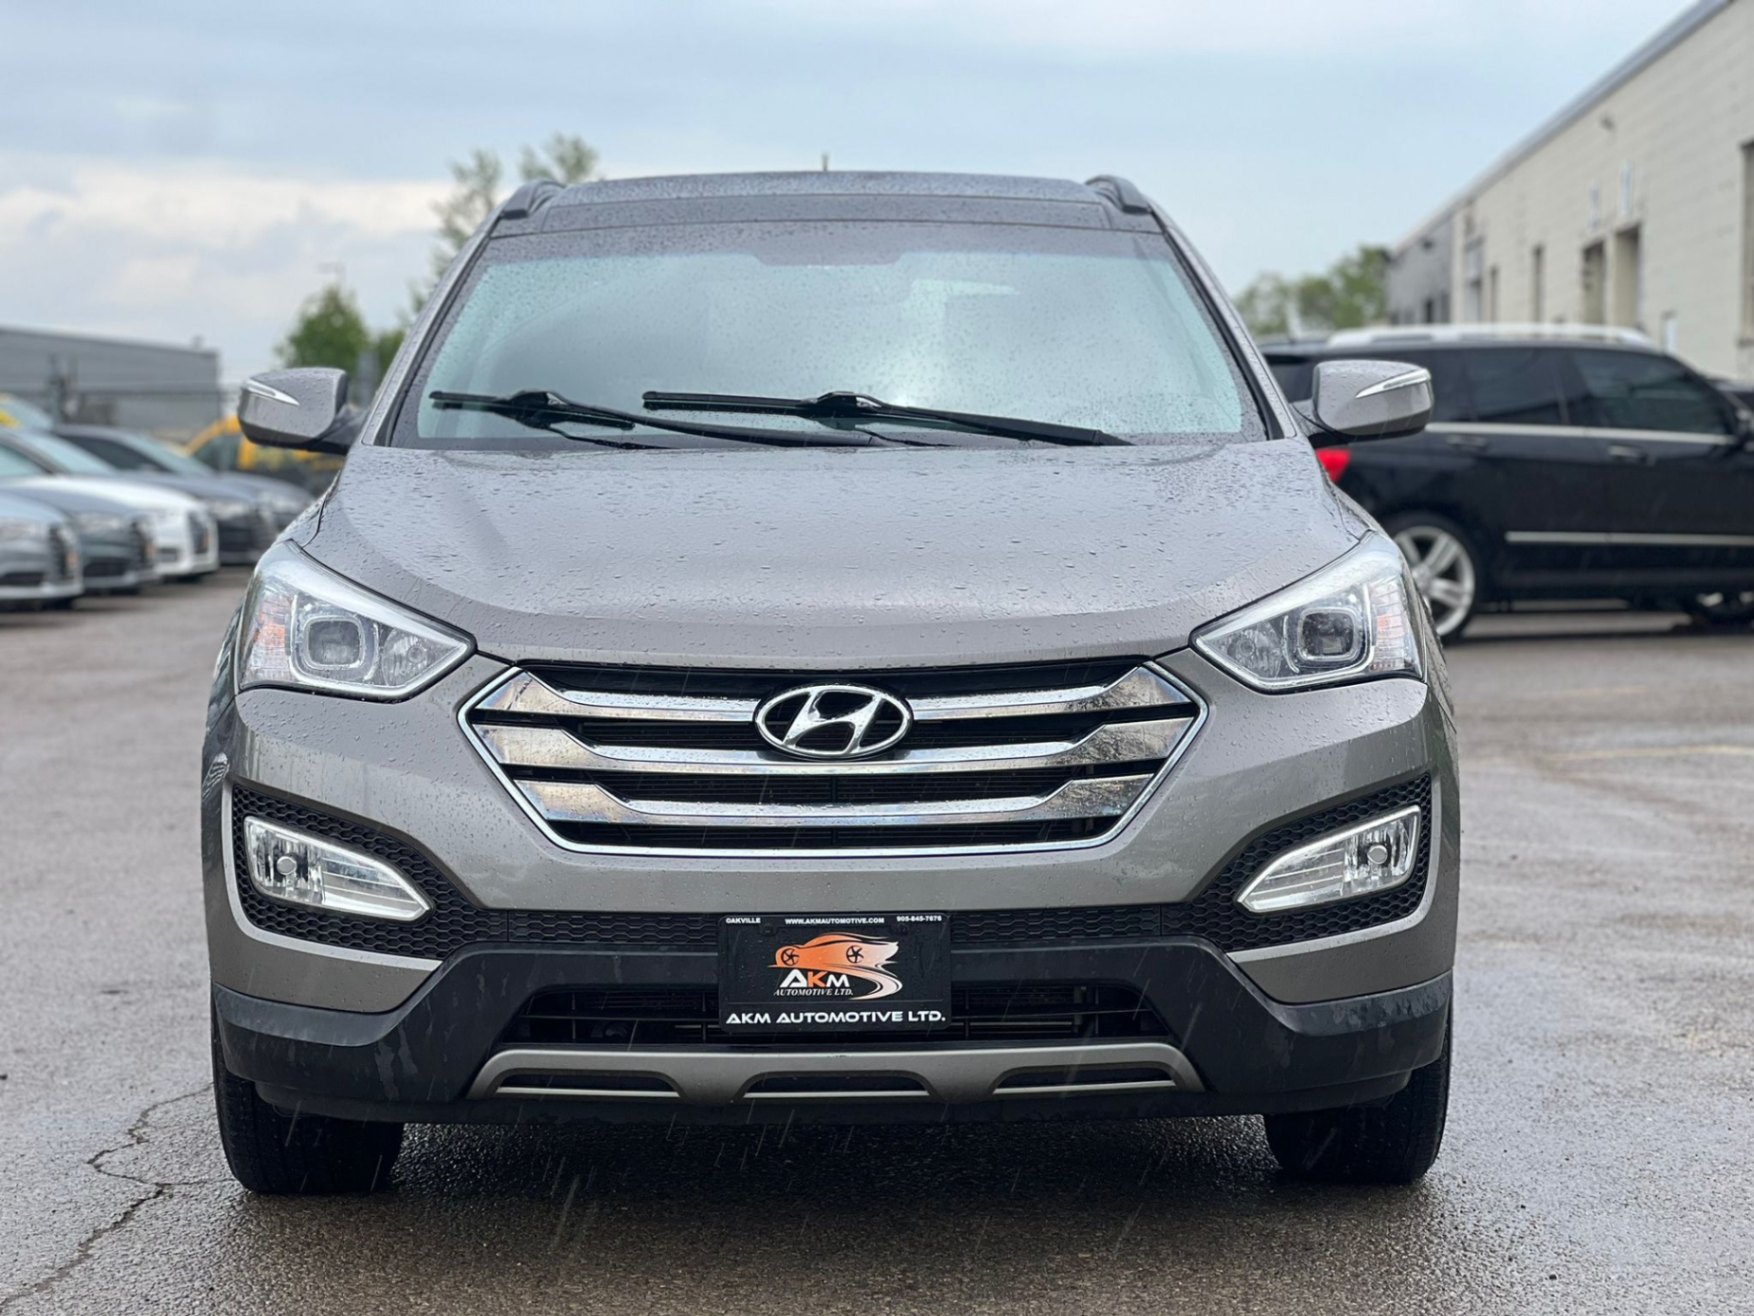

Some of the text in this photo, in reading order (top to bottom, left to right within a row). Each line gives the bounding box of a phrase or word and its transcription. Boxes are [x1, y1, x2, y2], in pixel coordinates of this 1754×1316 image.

[786, 917, 885, 925] WWW.AKMAUTOMOTIVE.COM
[780, 969, 850, 988] AKM
[774, 988, 854, 997] AUTOMOTIVE LTD.
[726, 1011, 946, 1024] AKM AUTOMOTIVE LTD.
